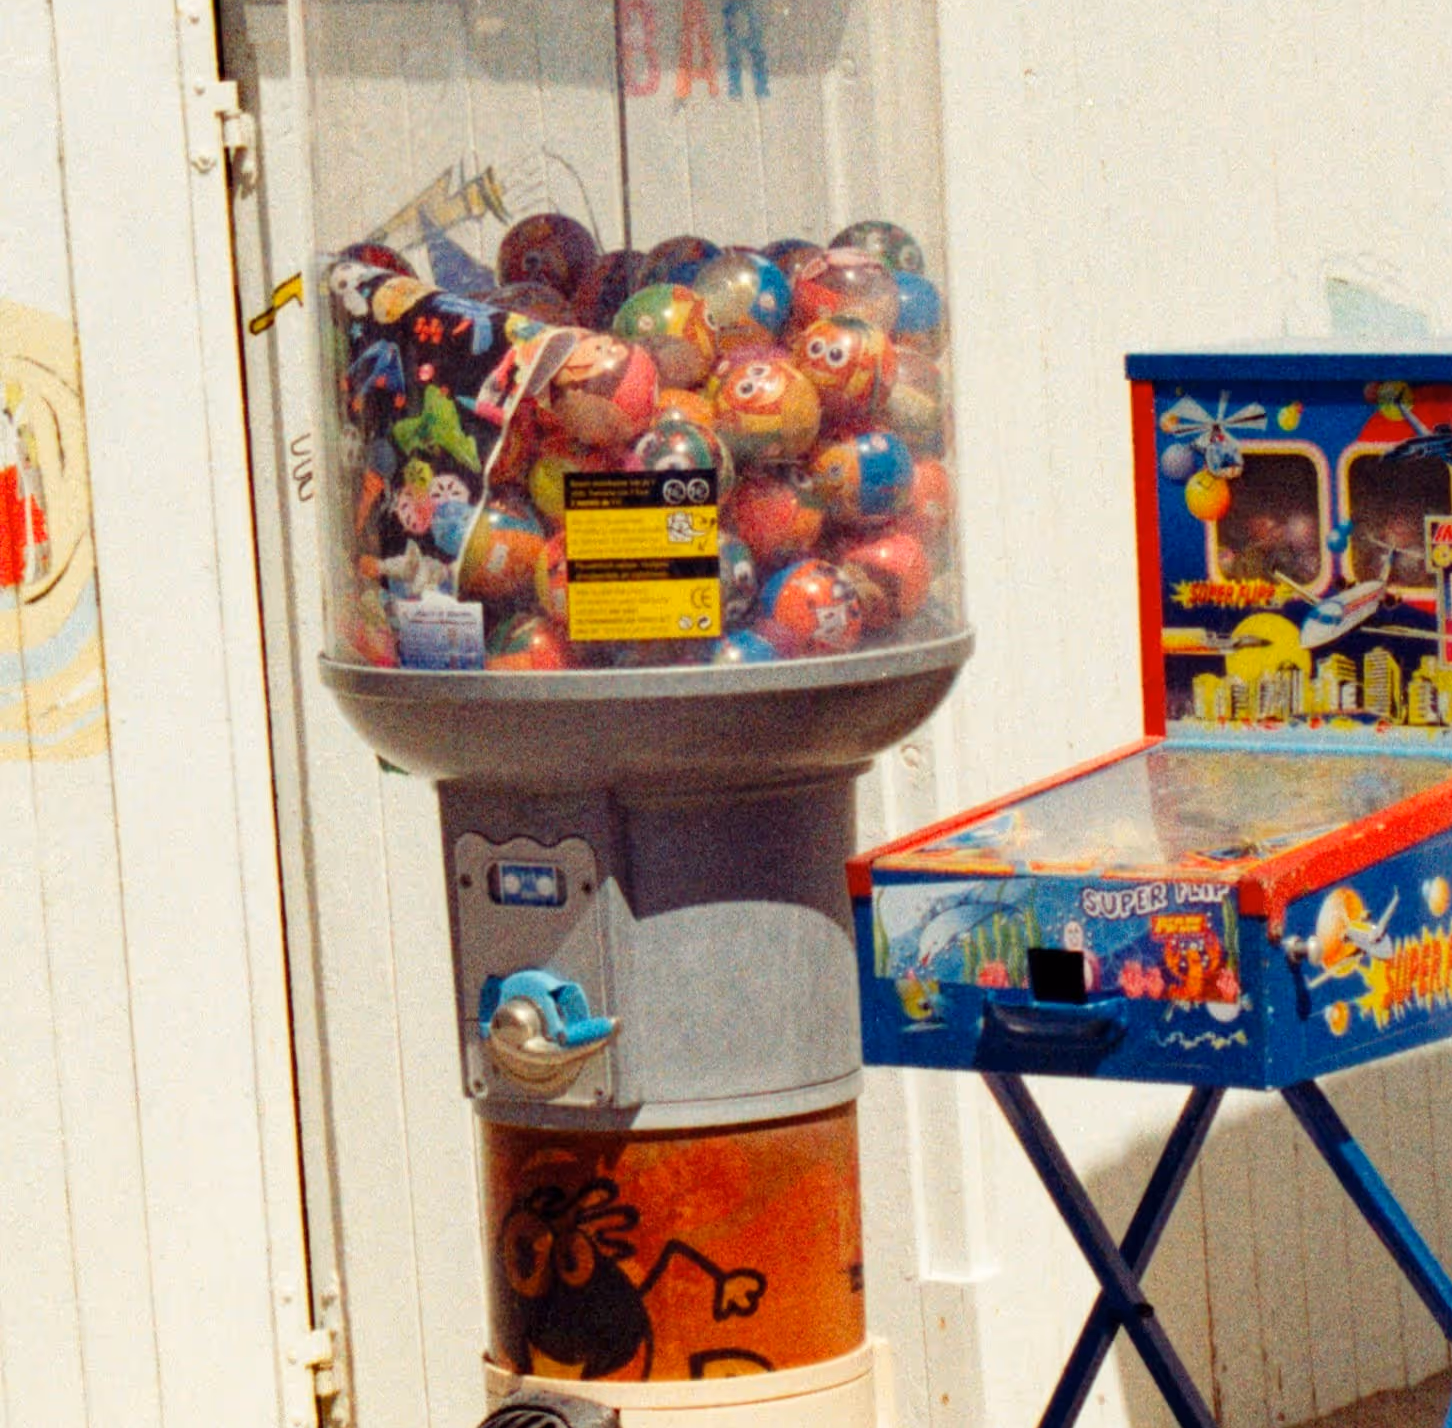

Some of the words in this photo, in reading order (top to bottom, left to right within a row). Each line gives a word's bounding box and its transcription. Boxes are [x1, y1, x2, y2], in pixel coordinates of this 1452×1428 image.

[1189, 582, 1234, 606] SUPER
[1082, 881, 1169, 919] SUPER
[1383, 939, 1443, 1011] SUPER
